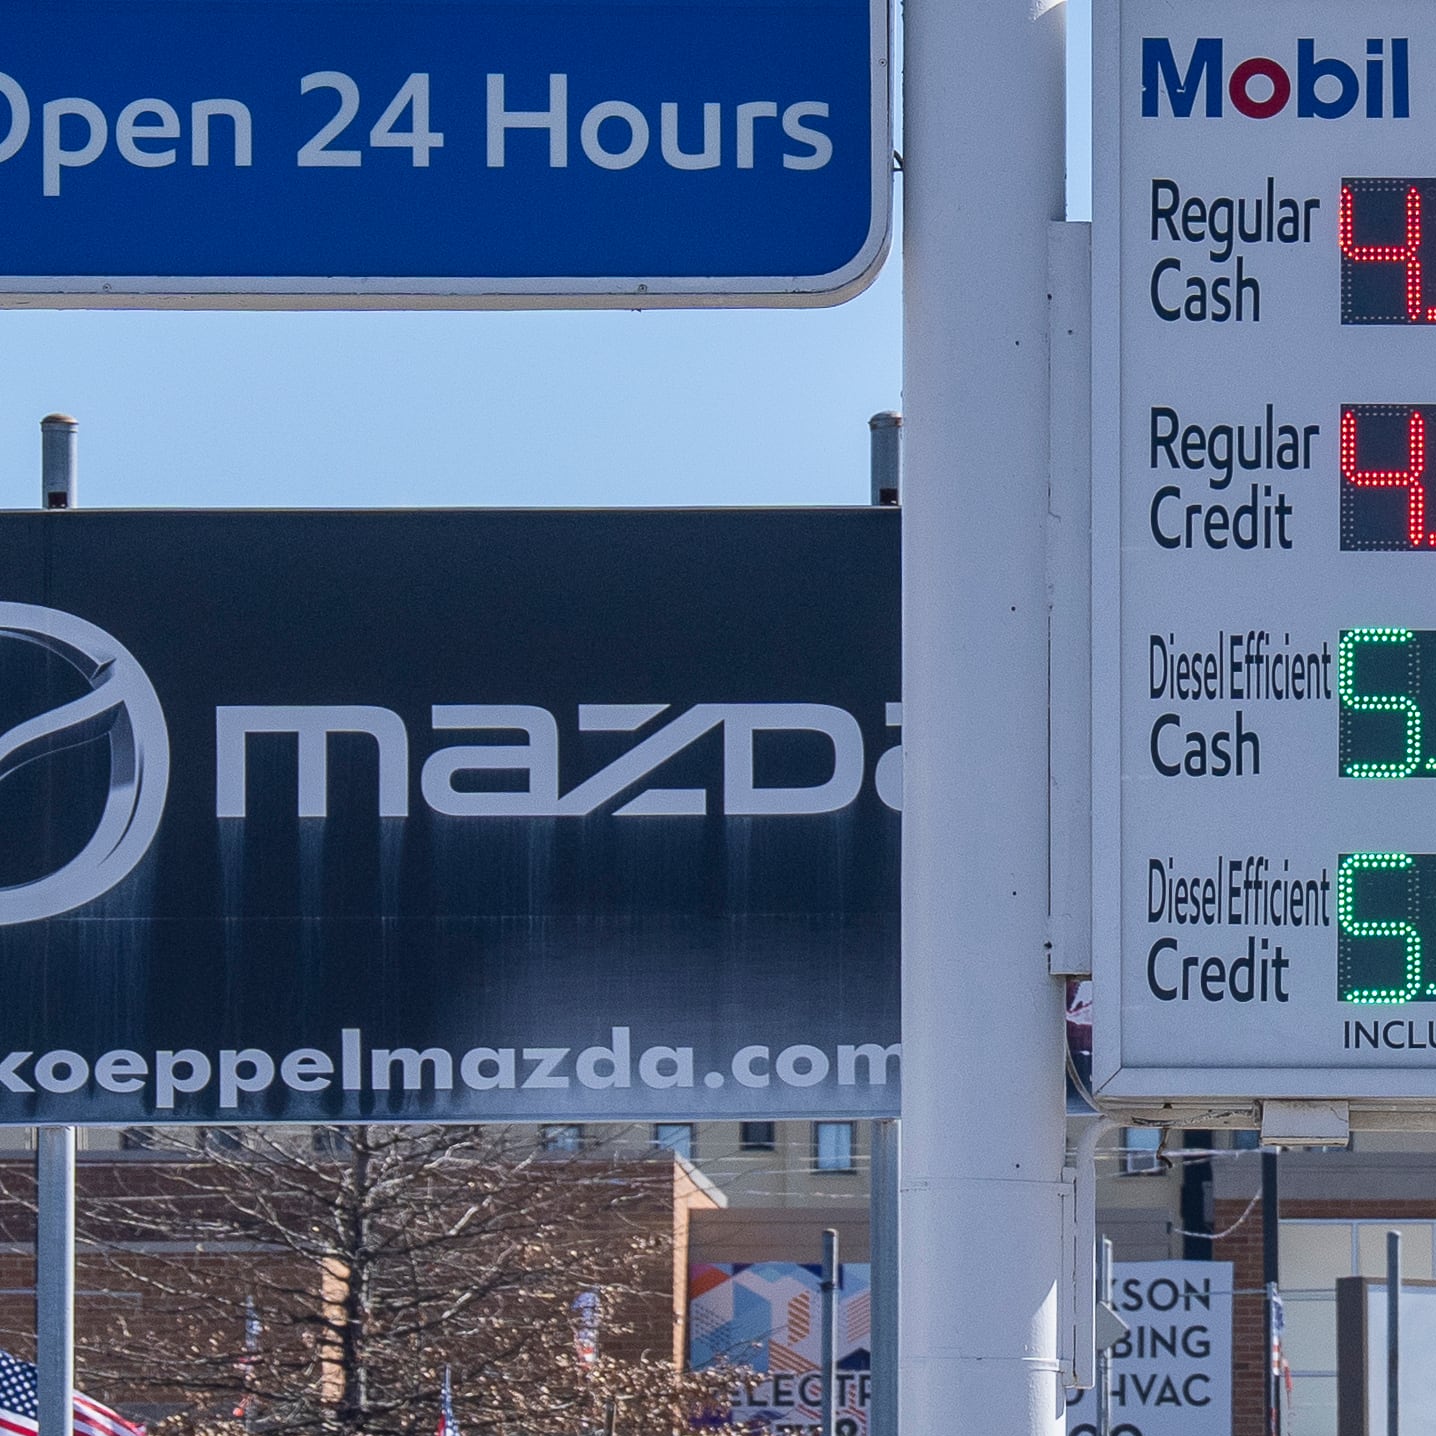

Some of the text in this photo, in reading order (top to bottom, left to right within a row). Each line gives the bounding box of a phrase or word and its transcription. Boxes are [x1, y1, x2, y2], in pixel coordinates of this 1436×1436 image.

[1141, 37, 1409, 119] Mobil
[297, 71, 444, 168] 24
[486, 72, 834, 171] Hours
[1151, 177, 1320, 263] Regular
[1151, 256, 1261, 322] Cash
[1151, 404, 1320, 489] Regular
[1150, 483, 1293, 550] Credit
[1149, 633, 1332, 701] Diesel Efficient
[1150, 711, 1261, 777] Cash
[1148, 855, 1331, 928] Diesel Efficient
[1147, 936, 1289, 1003] Credit
